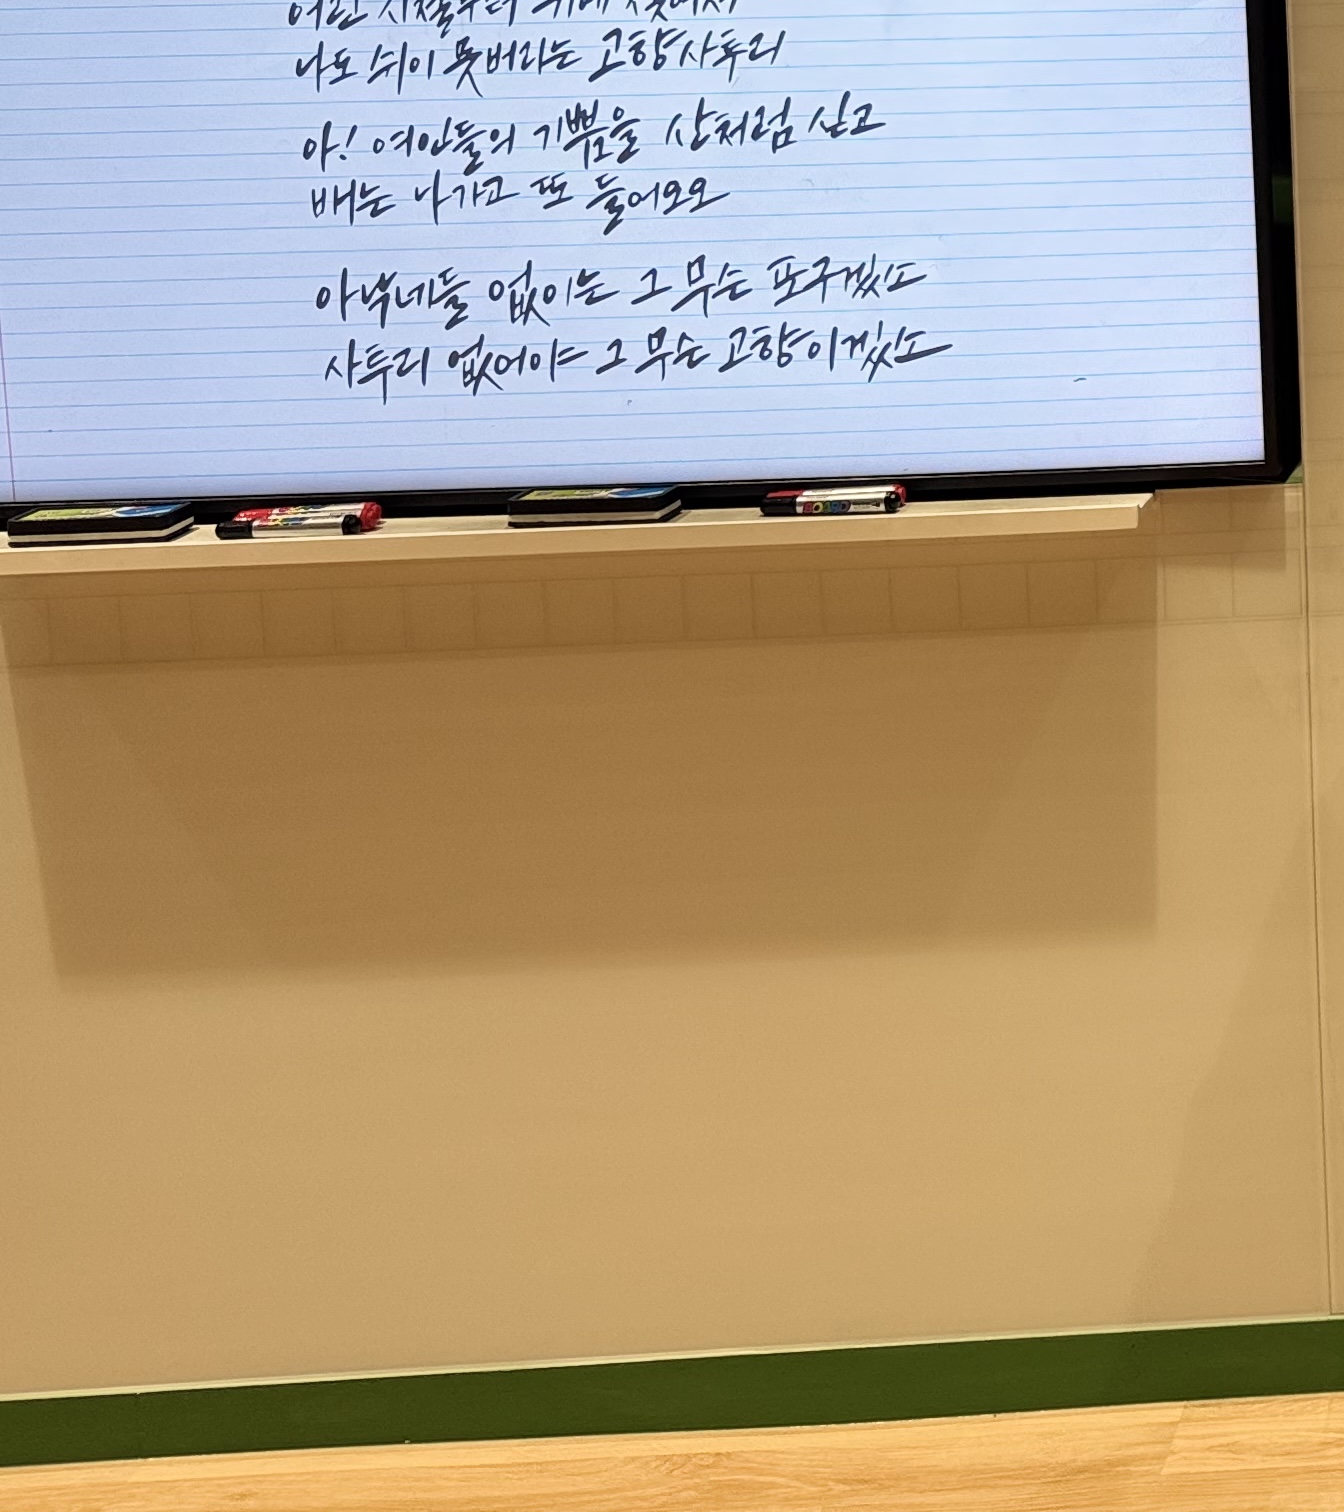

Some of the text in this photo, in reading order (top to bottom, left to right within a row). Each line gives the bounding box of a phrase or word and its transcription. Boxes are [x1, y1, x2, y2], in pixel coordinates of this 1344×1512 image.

[295, 40, 358, 93] 나도
[367, 41, 435, 95] 쉬이
[302, 120, 358, 172] 아!
[372, 116, 516, 177] 여인들의
[533, 99, 641, 170] 기쁨을
[665, 96, 797, 154] 산처럼
[311, 178, 396, 226] 배는
[529, 172, 574, 210] 또
[585, 173, 730, 236] 들어오오
[315, 253, 927, 331] 아낙네들 없이는 그 무슨 포구겠소
[324, 320, 953, 405] 사투리 없어야 그 무슨 고향이겠소
